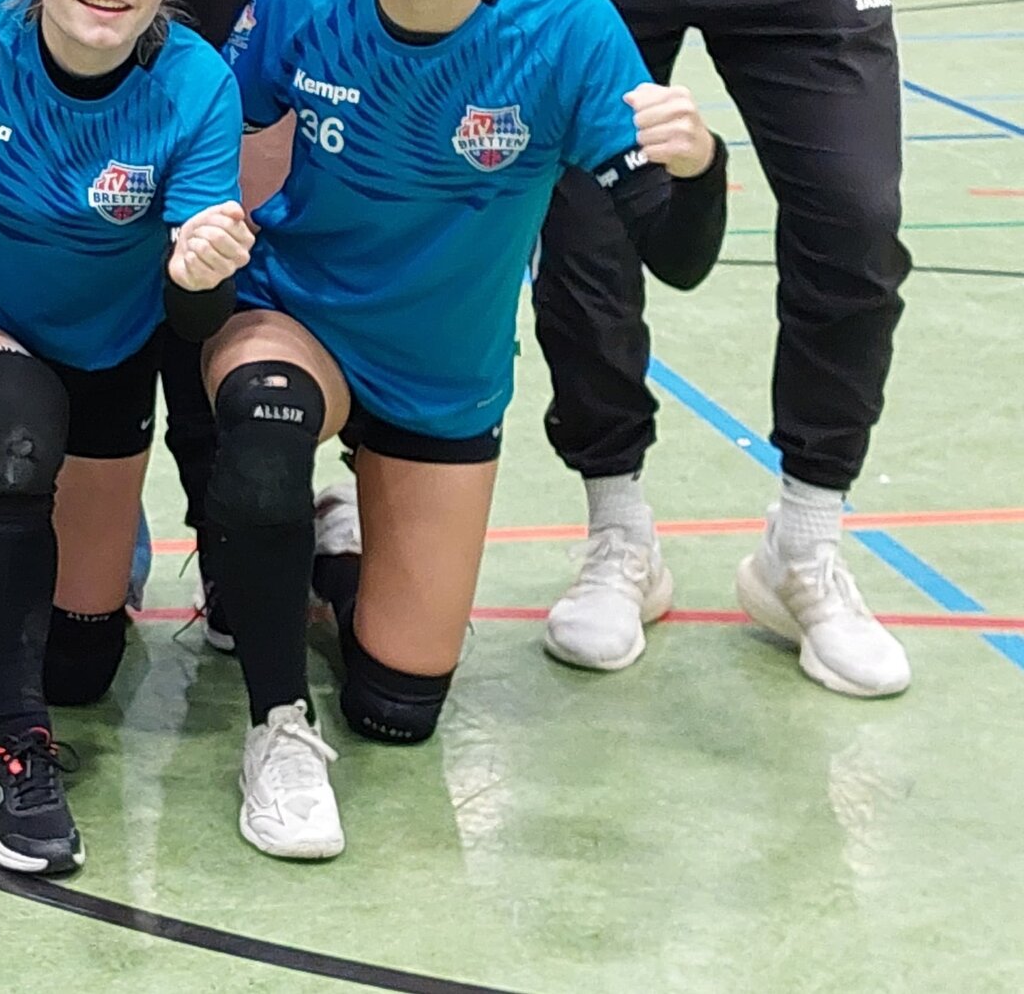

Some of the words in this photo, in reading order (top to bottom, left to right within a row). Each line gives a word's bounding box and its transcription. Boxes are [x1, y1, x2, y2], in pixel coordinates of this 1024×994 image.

[292, 67, 361, 105] Kempa
[299, 108, 345, 153] 36
[457, 136, 525, 150] BRETTEN
[103, 172, 126, 192] TV
[253, 404, 304, 423] ALLSIX
